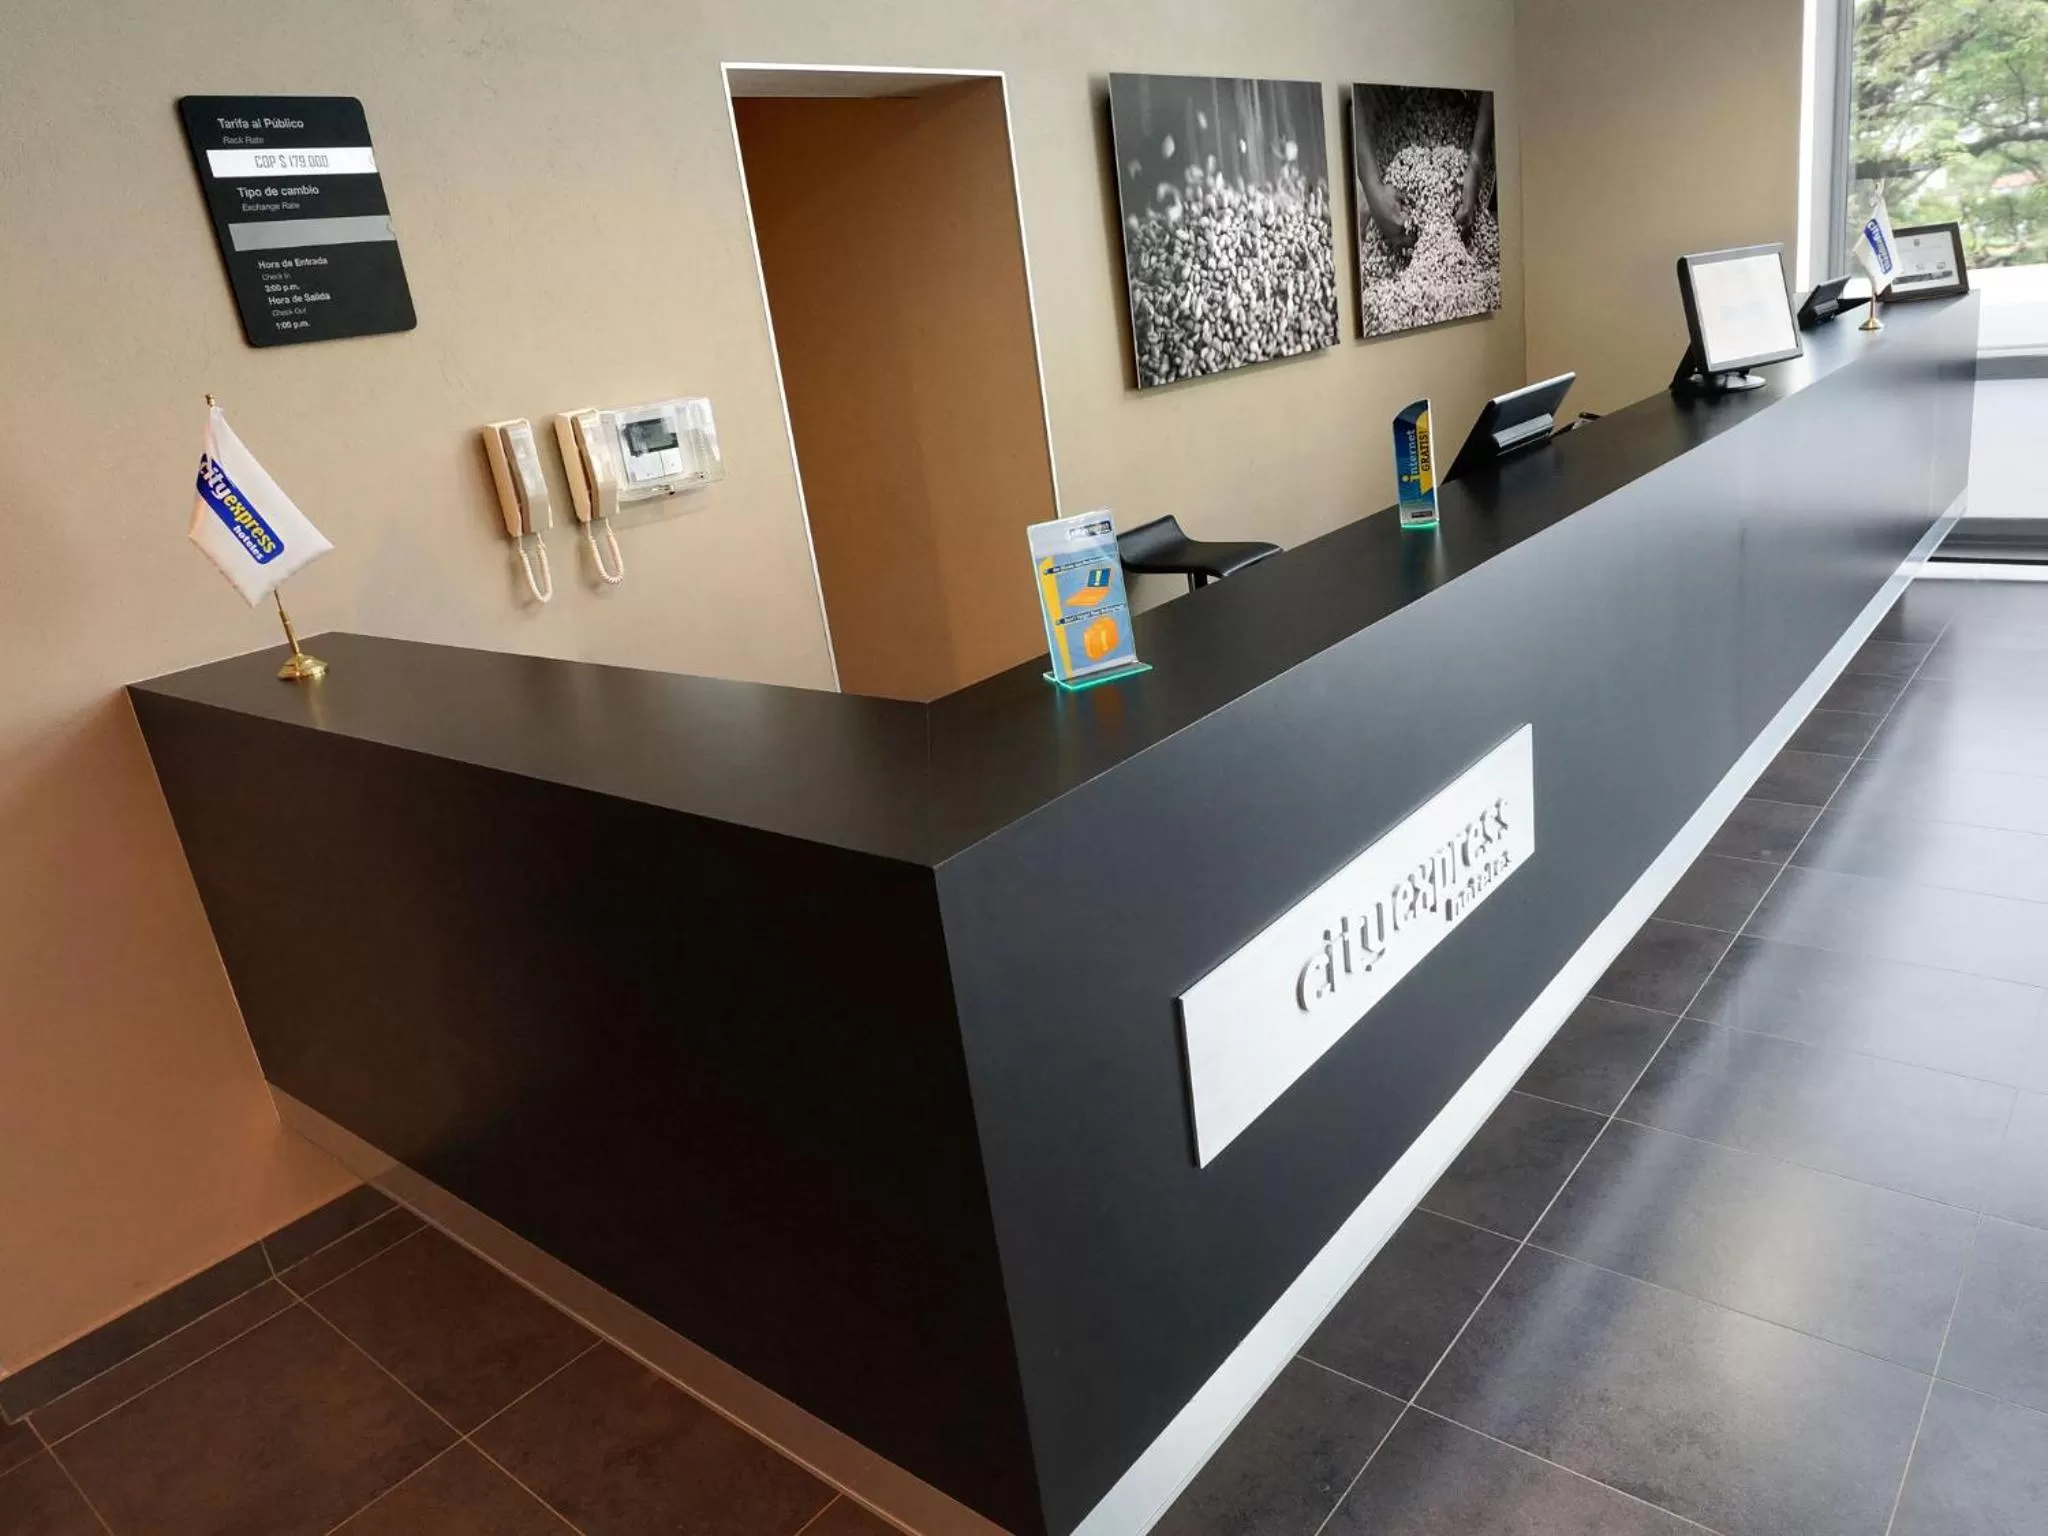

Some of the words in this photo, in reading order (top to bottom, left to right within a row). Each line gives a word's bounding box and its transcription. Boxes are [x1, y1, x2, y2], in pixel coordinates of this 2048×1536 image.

[217, 117, 250, 129] Tarifa
[251, 117, 262, 129] al
[262, 117, 304, 129] Público
[254, 154, 277, 169] COP
[236, 186, 262, 199] Tipo
[264, 186, 279, 197] de
[280, 185, 320, 196] cambio
[257, 260, 280, 269] Hora
[281, 259, 293, 268] de
[294, 256, 329, 267] Entrada
[267, 295, 291, 306] Hora
[291, 294, 304, 304] de
[304, 292, 331, 303] Salida
[233, 525, 265, 561] hoteles
[1296, 797, 1510, 1013] cityexpress
